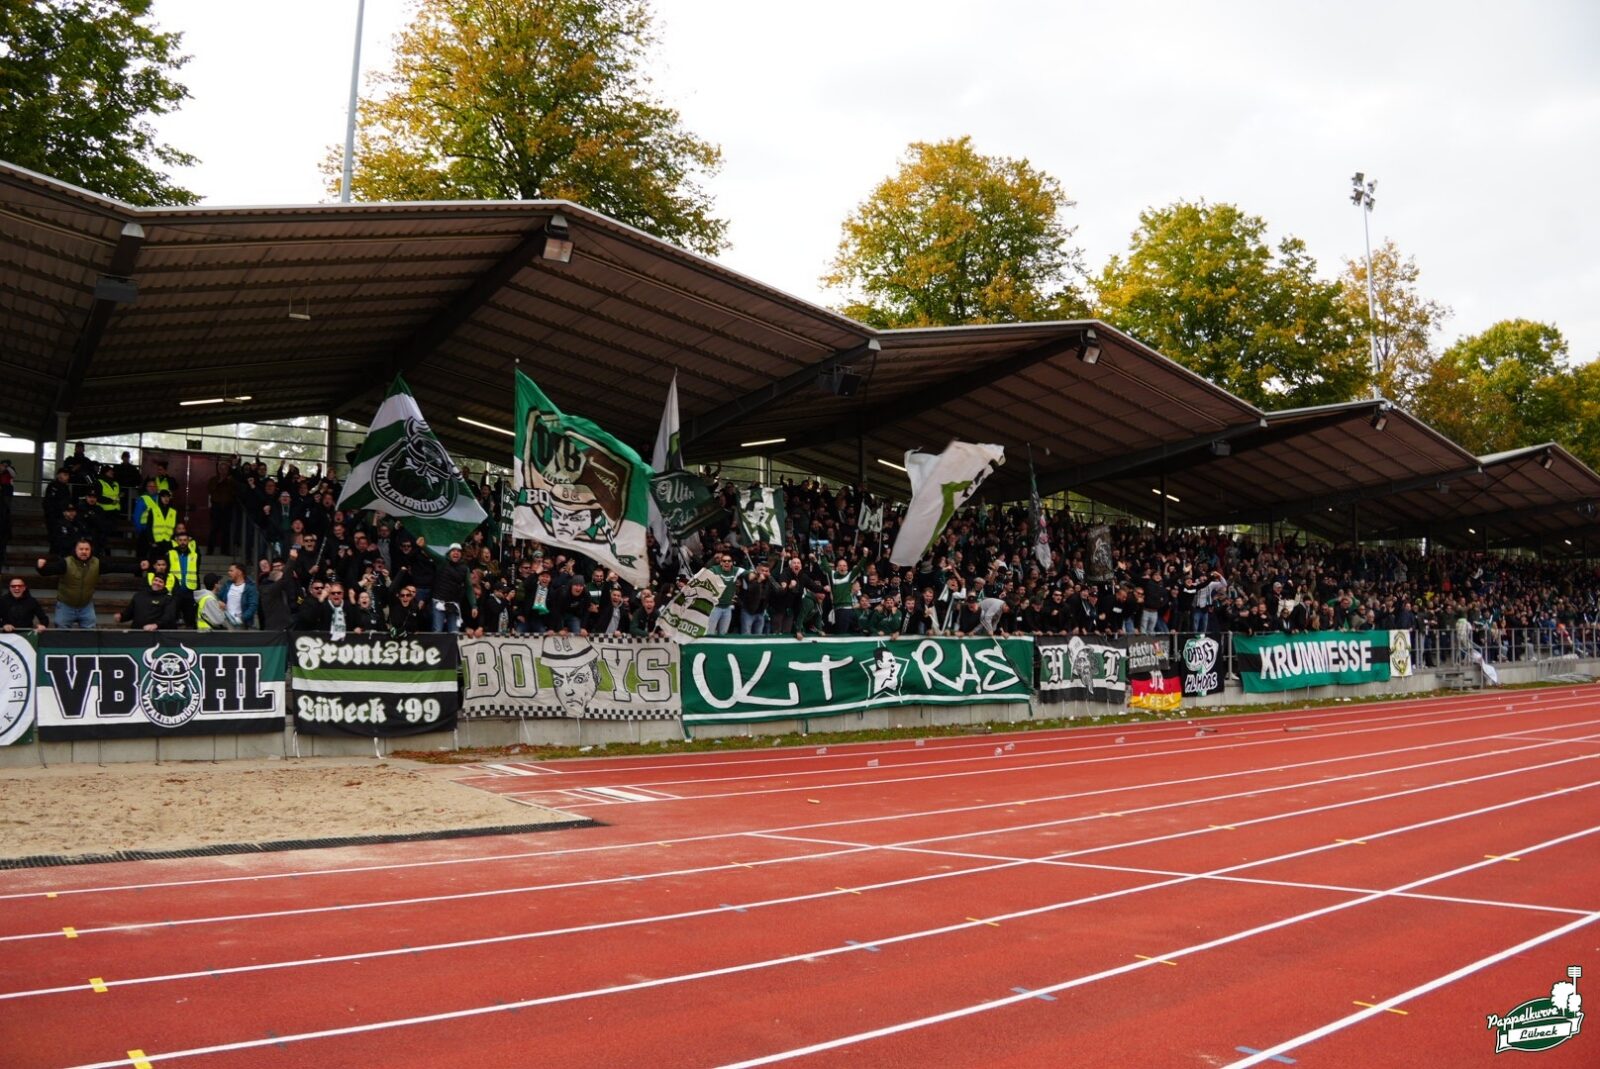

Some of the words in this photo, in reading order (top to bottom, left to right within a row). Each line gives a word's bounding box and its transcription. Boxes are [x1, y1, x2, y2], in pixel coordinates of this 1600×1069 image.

[376, 460, 451, 512] VITALIENBRÜDER
[295, 635, 442, 670] Frontside
[1258, 640, 1372, 680] KRUMMESSE
[45, 653, 140, 719] VB
[199, 653, 277, 714] HL
[141, 691, 201, 725] VITALIENBRÜDER
[297, 695, 387, 723] Lübeck
